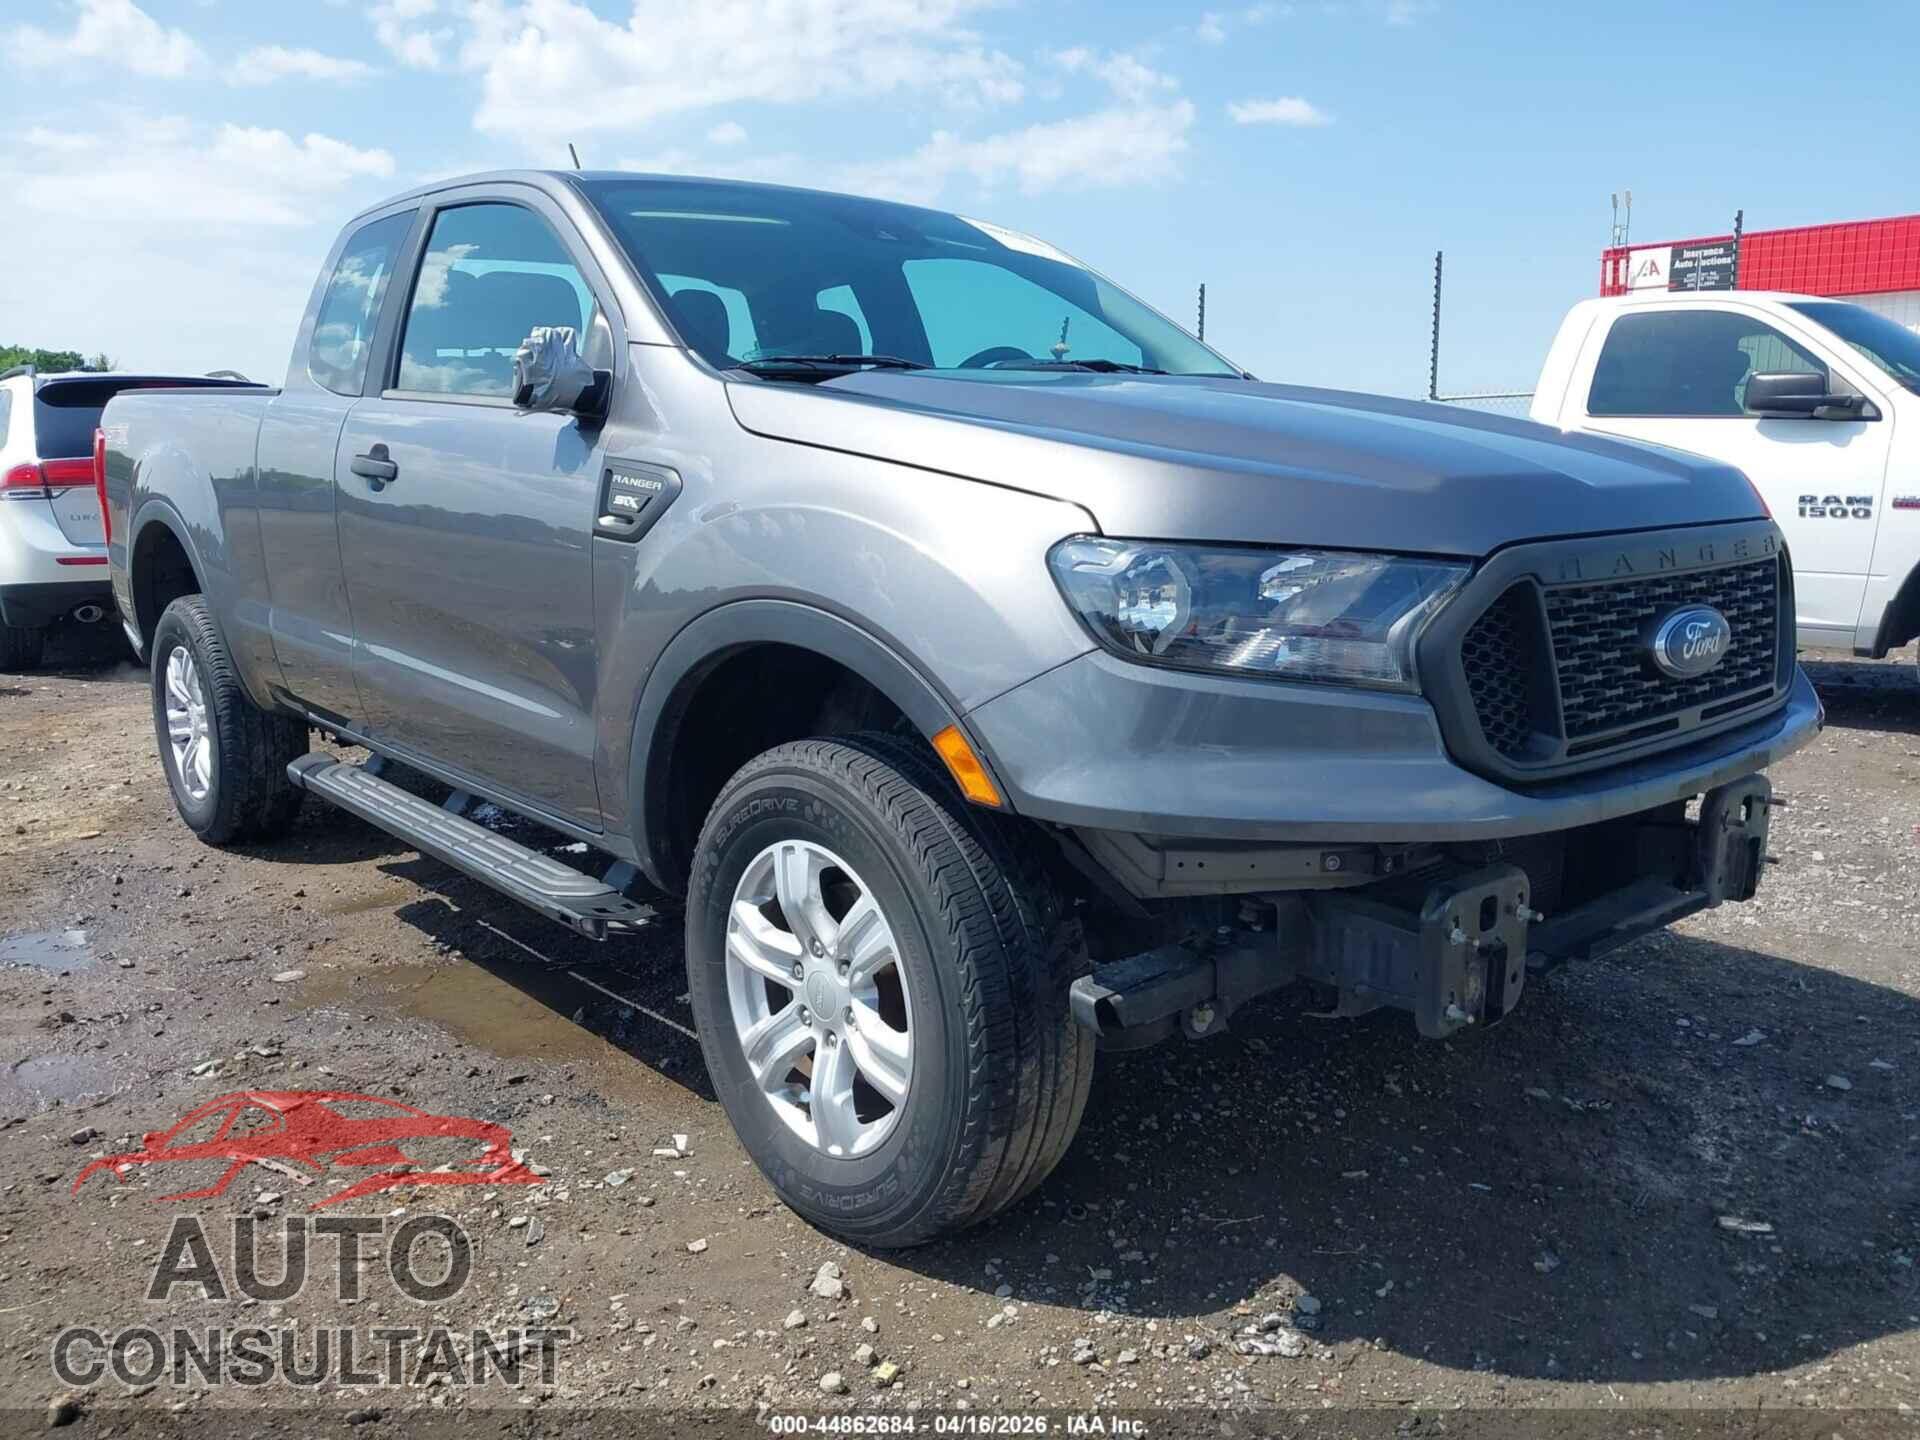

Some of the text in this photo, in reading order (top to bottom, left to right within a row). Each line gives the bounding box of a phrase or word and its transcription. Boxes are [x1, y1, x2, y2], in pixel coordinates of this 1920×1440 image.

[1674, 259, 1693, 269] Auto
[612, 474, 662, 491] RANGER
[1798, 495, 1873, 506] RAM
[1798, 506, 1872, 519] 1500
[1559, 535, 1776, 580] RANGER
[1683, 621, 1720, 659] Ford
